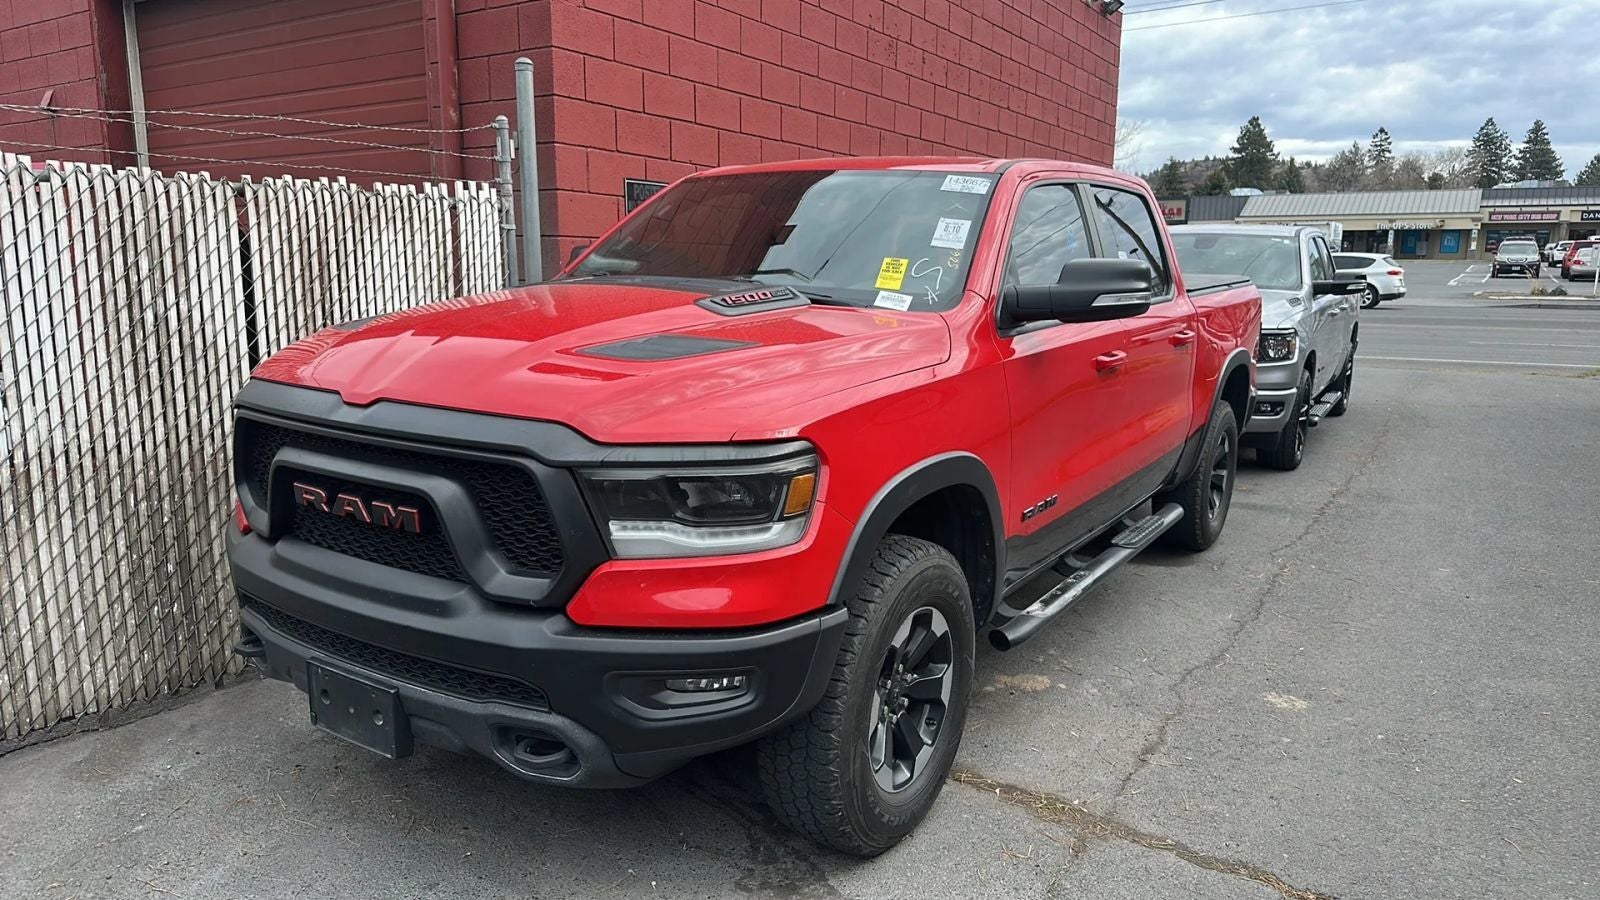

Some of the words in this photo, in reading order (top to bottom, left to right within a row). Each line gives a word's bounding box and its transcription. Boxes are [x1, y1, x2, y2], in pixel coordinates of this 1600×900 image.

[943, 224, 961, 233] 8:10
[1376, 222, 1390, 230] The
[1392, 222, 1409, 230] UPS
[1410, 222, 1433, 230] Store
[721, 290, 772, 305] 1500
[293, 482, 420, 534] RAM
[1022, 494, 1058, 521] RAM
